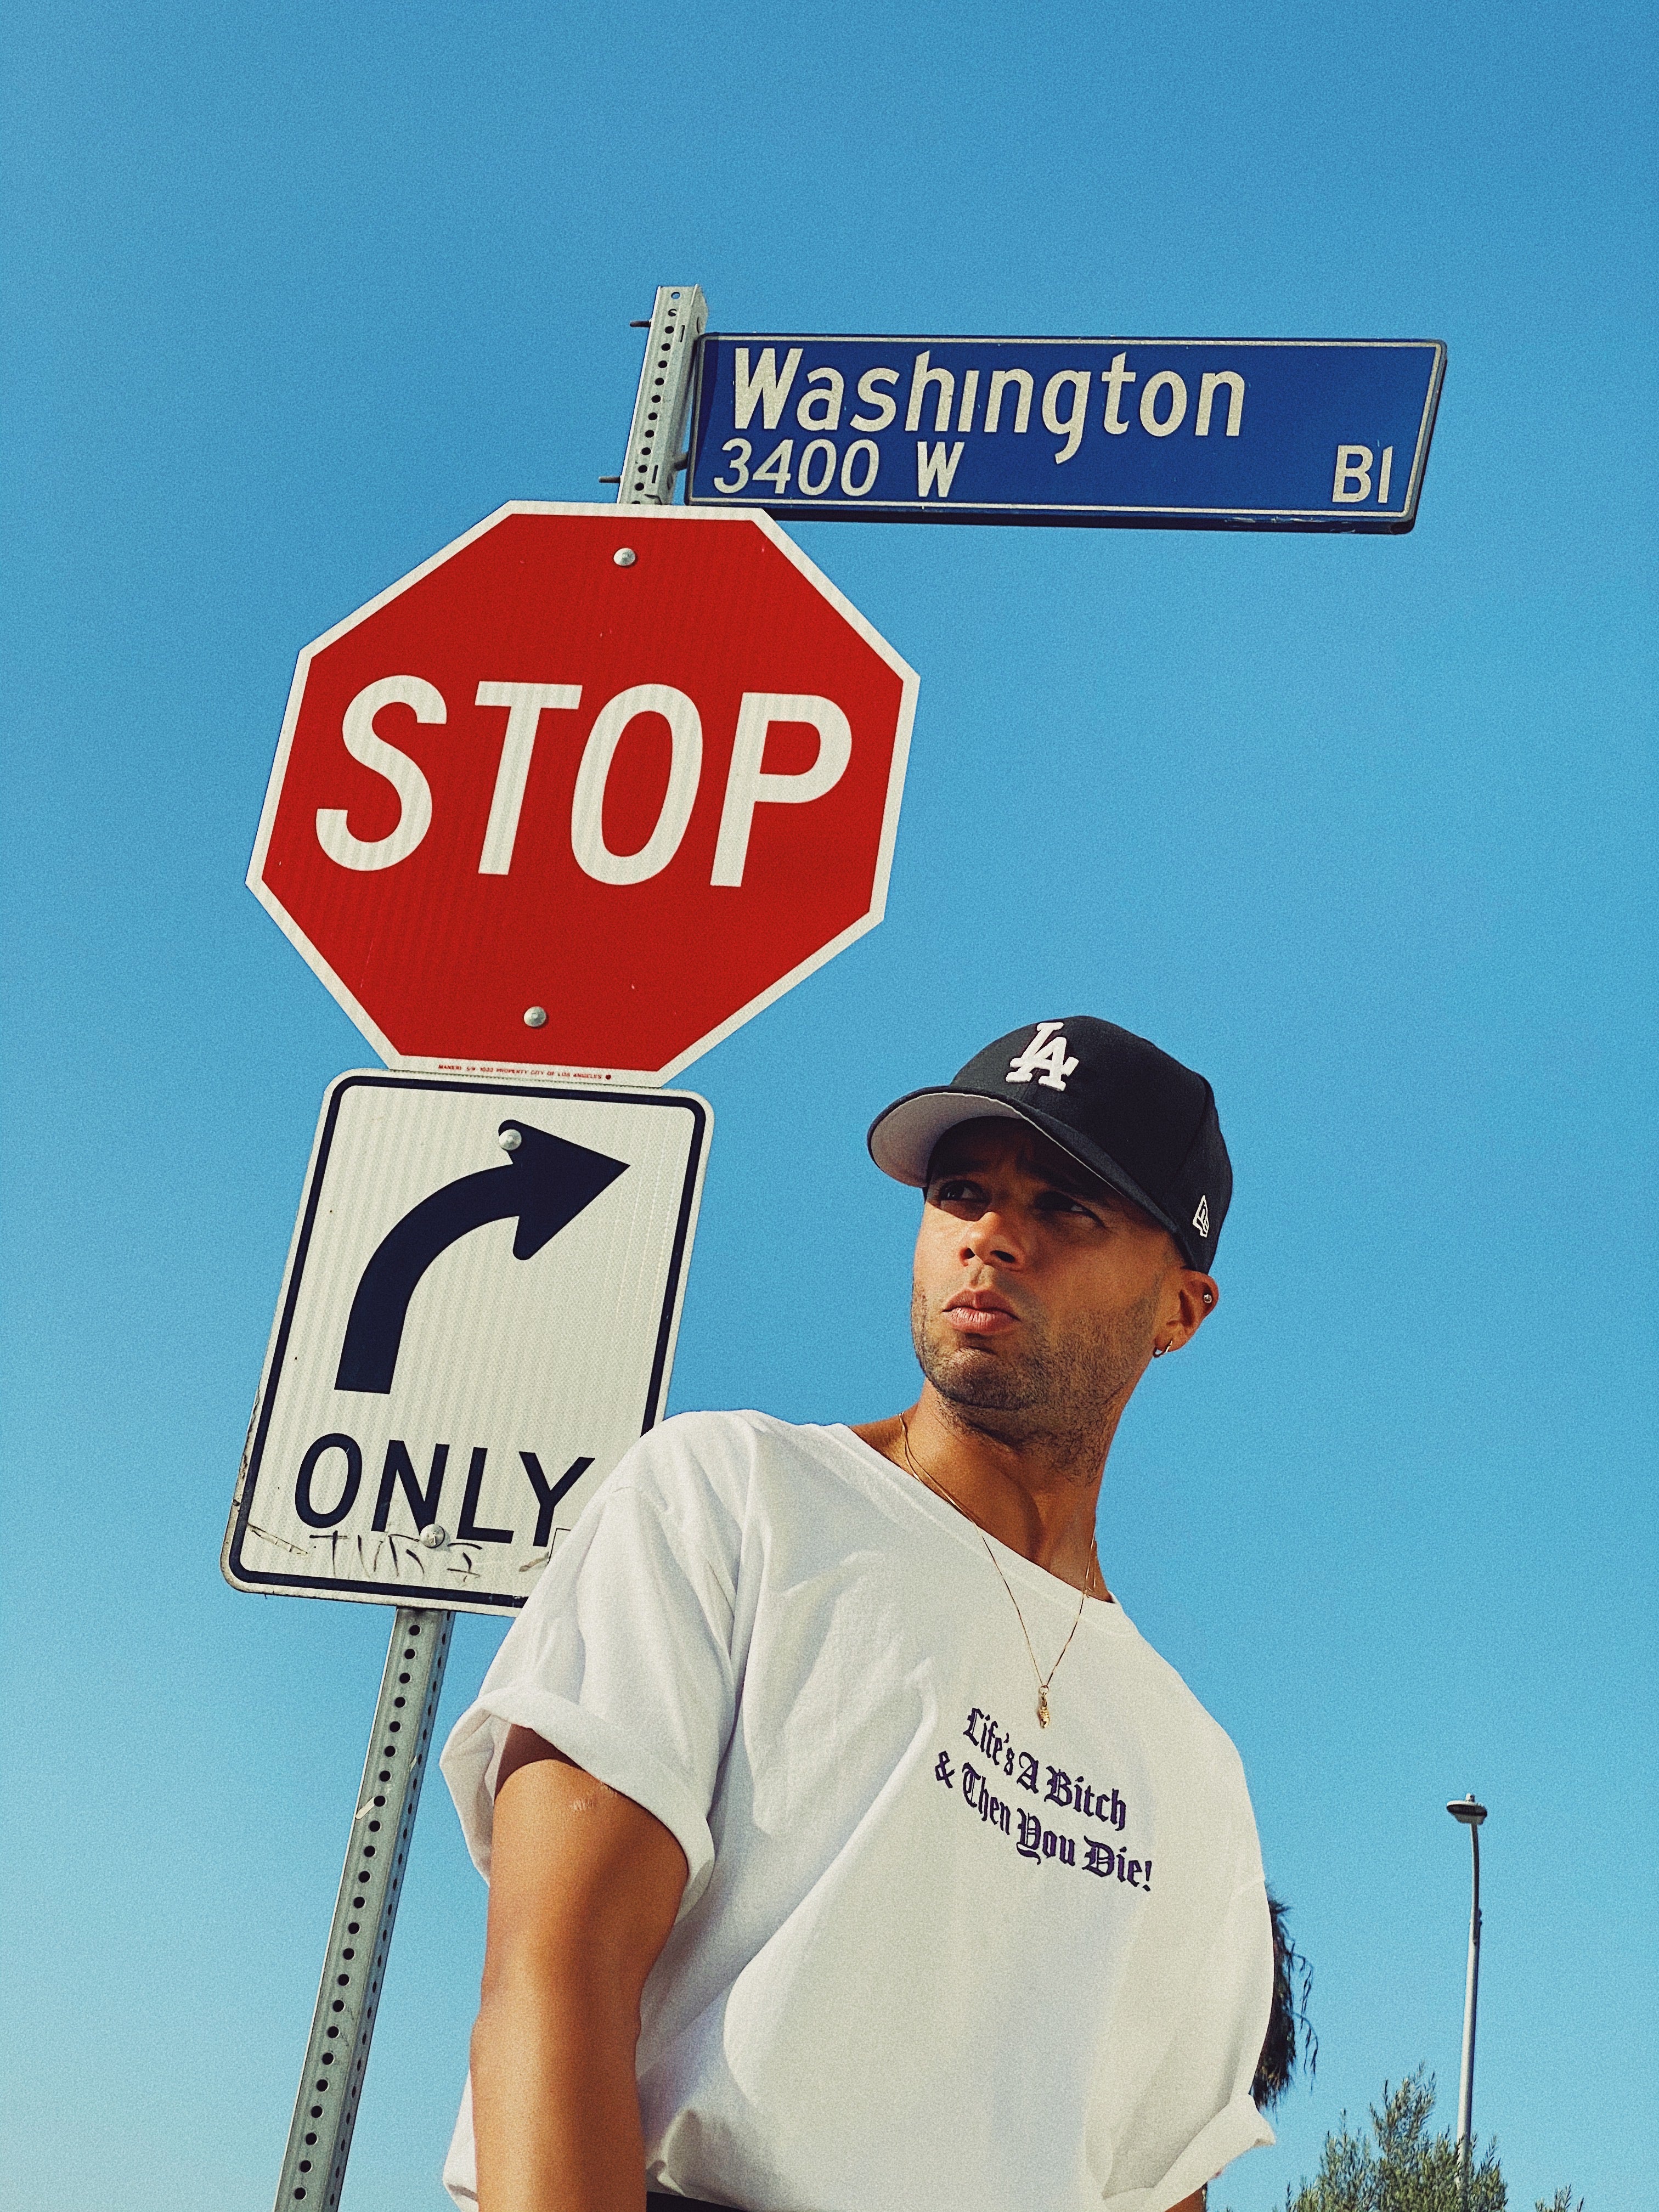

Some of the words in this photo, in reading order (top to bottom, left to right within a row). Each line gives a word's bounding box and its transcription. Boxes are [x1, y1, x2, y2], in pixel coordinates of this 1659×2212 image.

[733, 347, 1245, 465] Washington
[713, 438, 879, 497] 3400
[917, 441, 964, 498] W
[315, 674, 853, 888] STOP
[1005, 1021, 1080, 1092] LA
[294, 1432, 596, 1548] ONLY
[934, 1750, 956, 1789] &
[962, 1762, 1011, 1836] Then
[1015, 1808, 1076, 1867] You
[1081, 1835, 1153, 1892] Die!
[963, 1707, 1015, 1776] Life's
[1015, 1751, 1039, 1794] A
[1043, 1765, 1126, 1832] Bitch
